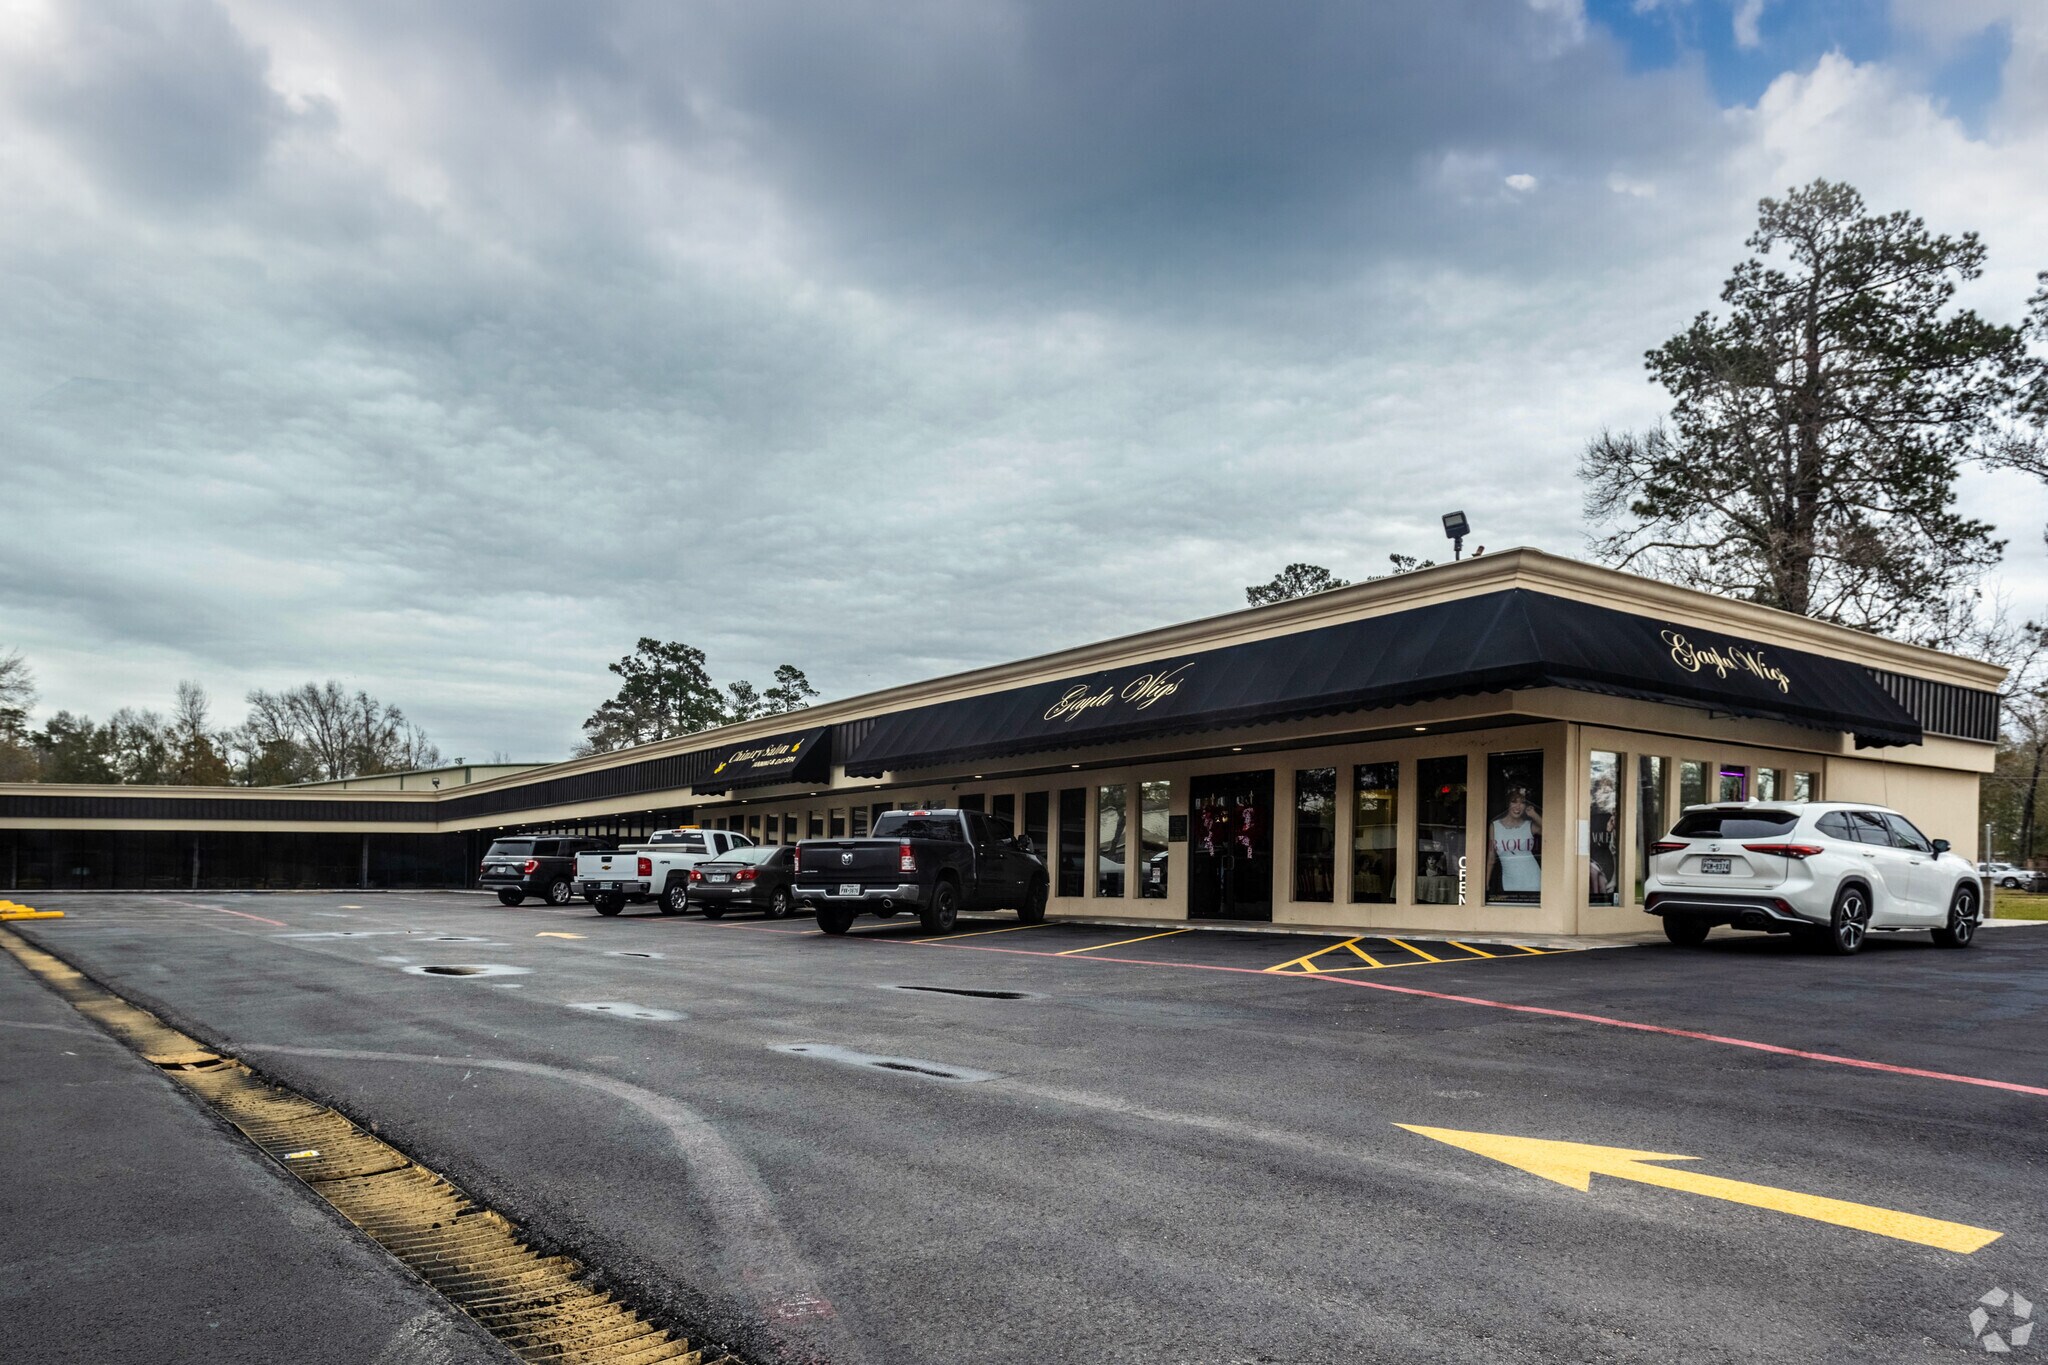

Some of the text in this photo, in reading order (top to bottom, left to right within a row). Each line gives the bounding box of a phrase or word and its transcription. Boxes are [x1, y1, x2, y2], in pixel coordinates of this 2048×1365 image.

[1043, 662, 1195, 722] Gayla Wigs
[1660, 629, 1790, 694] Gayla Wigs
